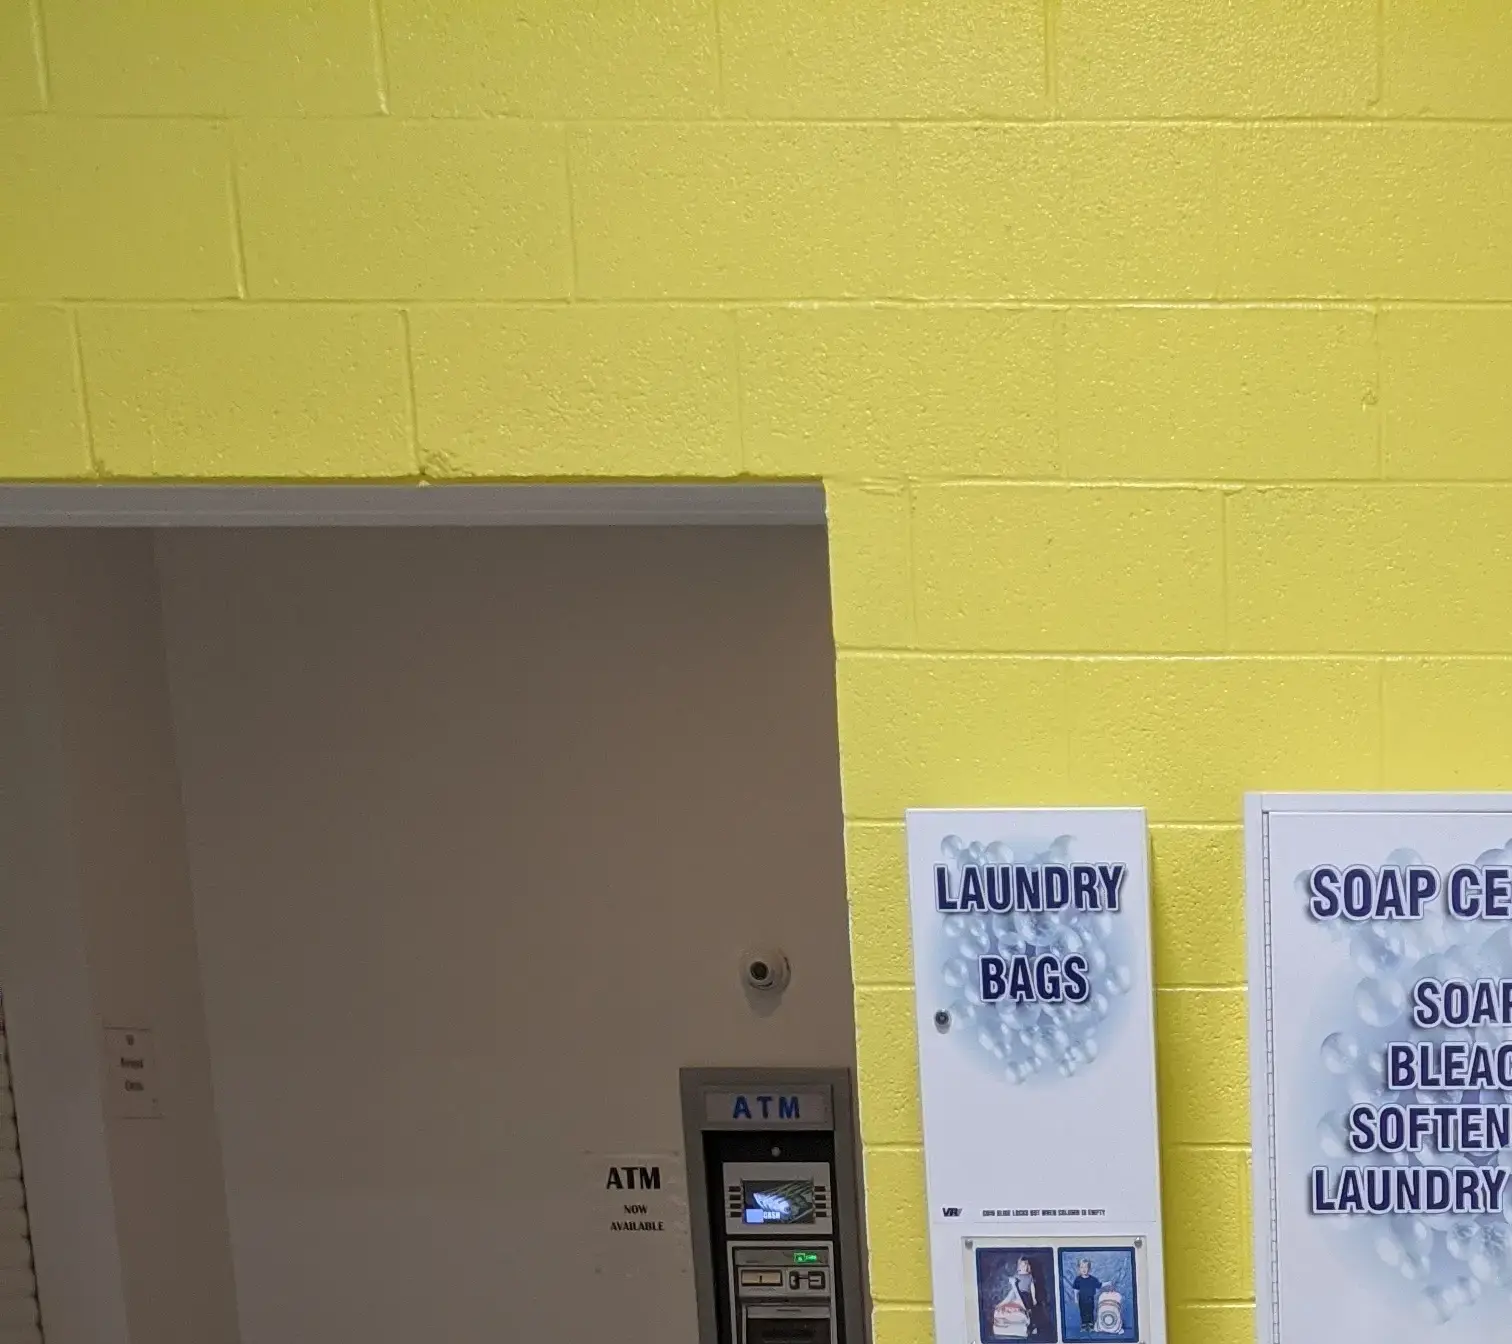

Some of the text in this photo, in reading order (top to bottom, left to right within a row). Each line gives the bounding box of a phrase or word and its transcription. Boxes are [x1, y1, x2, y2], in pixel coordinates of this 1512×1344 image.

[935, 865, 1125, 912] LAUNDRY
[1313, 867, 1437, 918] SOAP
[980, 955, 1088, 1001] BAGS
[732, 1096, 801, 1120] ATM
[606, 1166, 661, 1189] ATM
[1314, 1168, 1507, 1212] LAUNDRY
[610, 1221, 665, 1231] AVAILABLE
[624, 1204, 648, 1214] NOW
